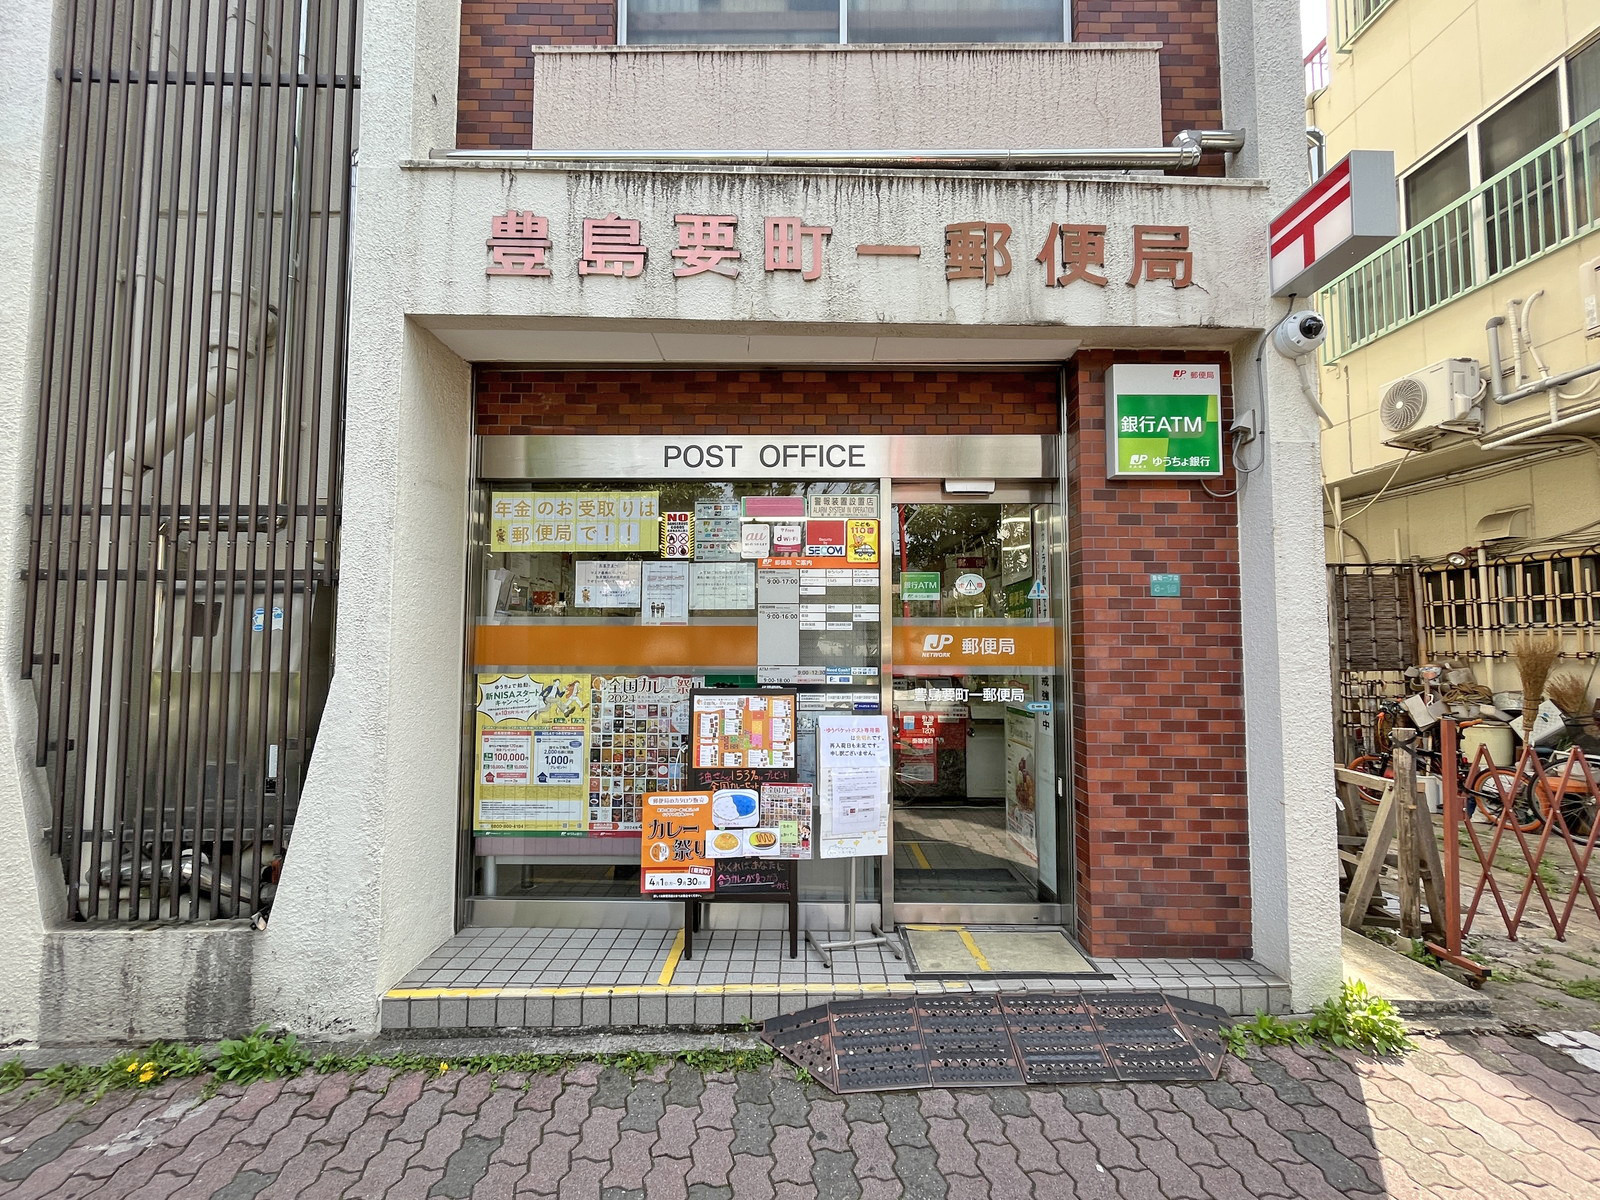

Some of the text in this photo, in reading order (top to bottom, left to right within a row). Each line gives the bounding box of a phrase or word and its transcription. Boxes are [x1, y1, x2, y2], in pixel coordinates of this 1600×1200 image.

[486, 210, 1194, 288] 豊島要町一郵便局
[1190, 371, 1215, 380] 郵便局
[1120, 415, 1203, 433] 銀行ATM
[664, 445, 866, 468] POST OFFICE
[1152, 456, 1211, 467] ゆうちょ銀行
[494, 501, 655, 518] 年金のお受取りは
[813, 506, 828, 514] ALARM
[829, 506, 846, 514] SYSTEM
[853, 506, 875, 514] OPERATION
[667, 513, 689, 522] NO
[745, 532, 767, 541] au
[808, 546, 843, 555] SECOM
[904, 581, 937, 589] 銀行ATM
[961, 637, 1016, 656] 郵便局
[485, 688, 540, 701] 新NISAスタート
[607, 694, 636, 703] 2024
[913, 687, 1026, 703] 豊島要町一郵便局
[495, 697, 531, 707] キャンペーン
[545, 755, 574, 766] 1,000円
[647, 818, 700, 841] カレー
[672, 837, 707, 862] 祭り
